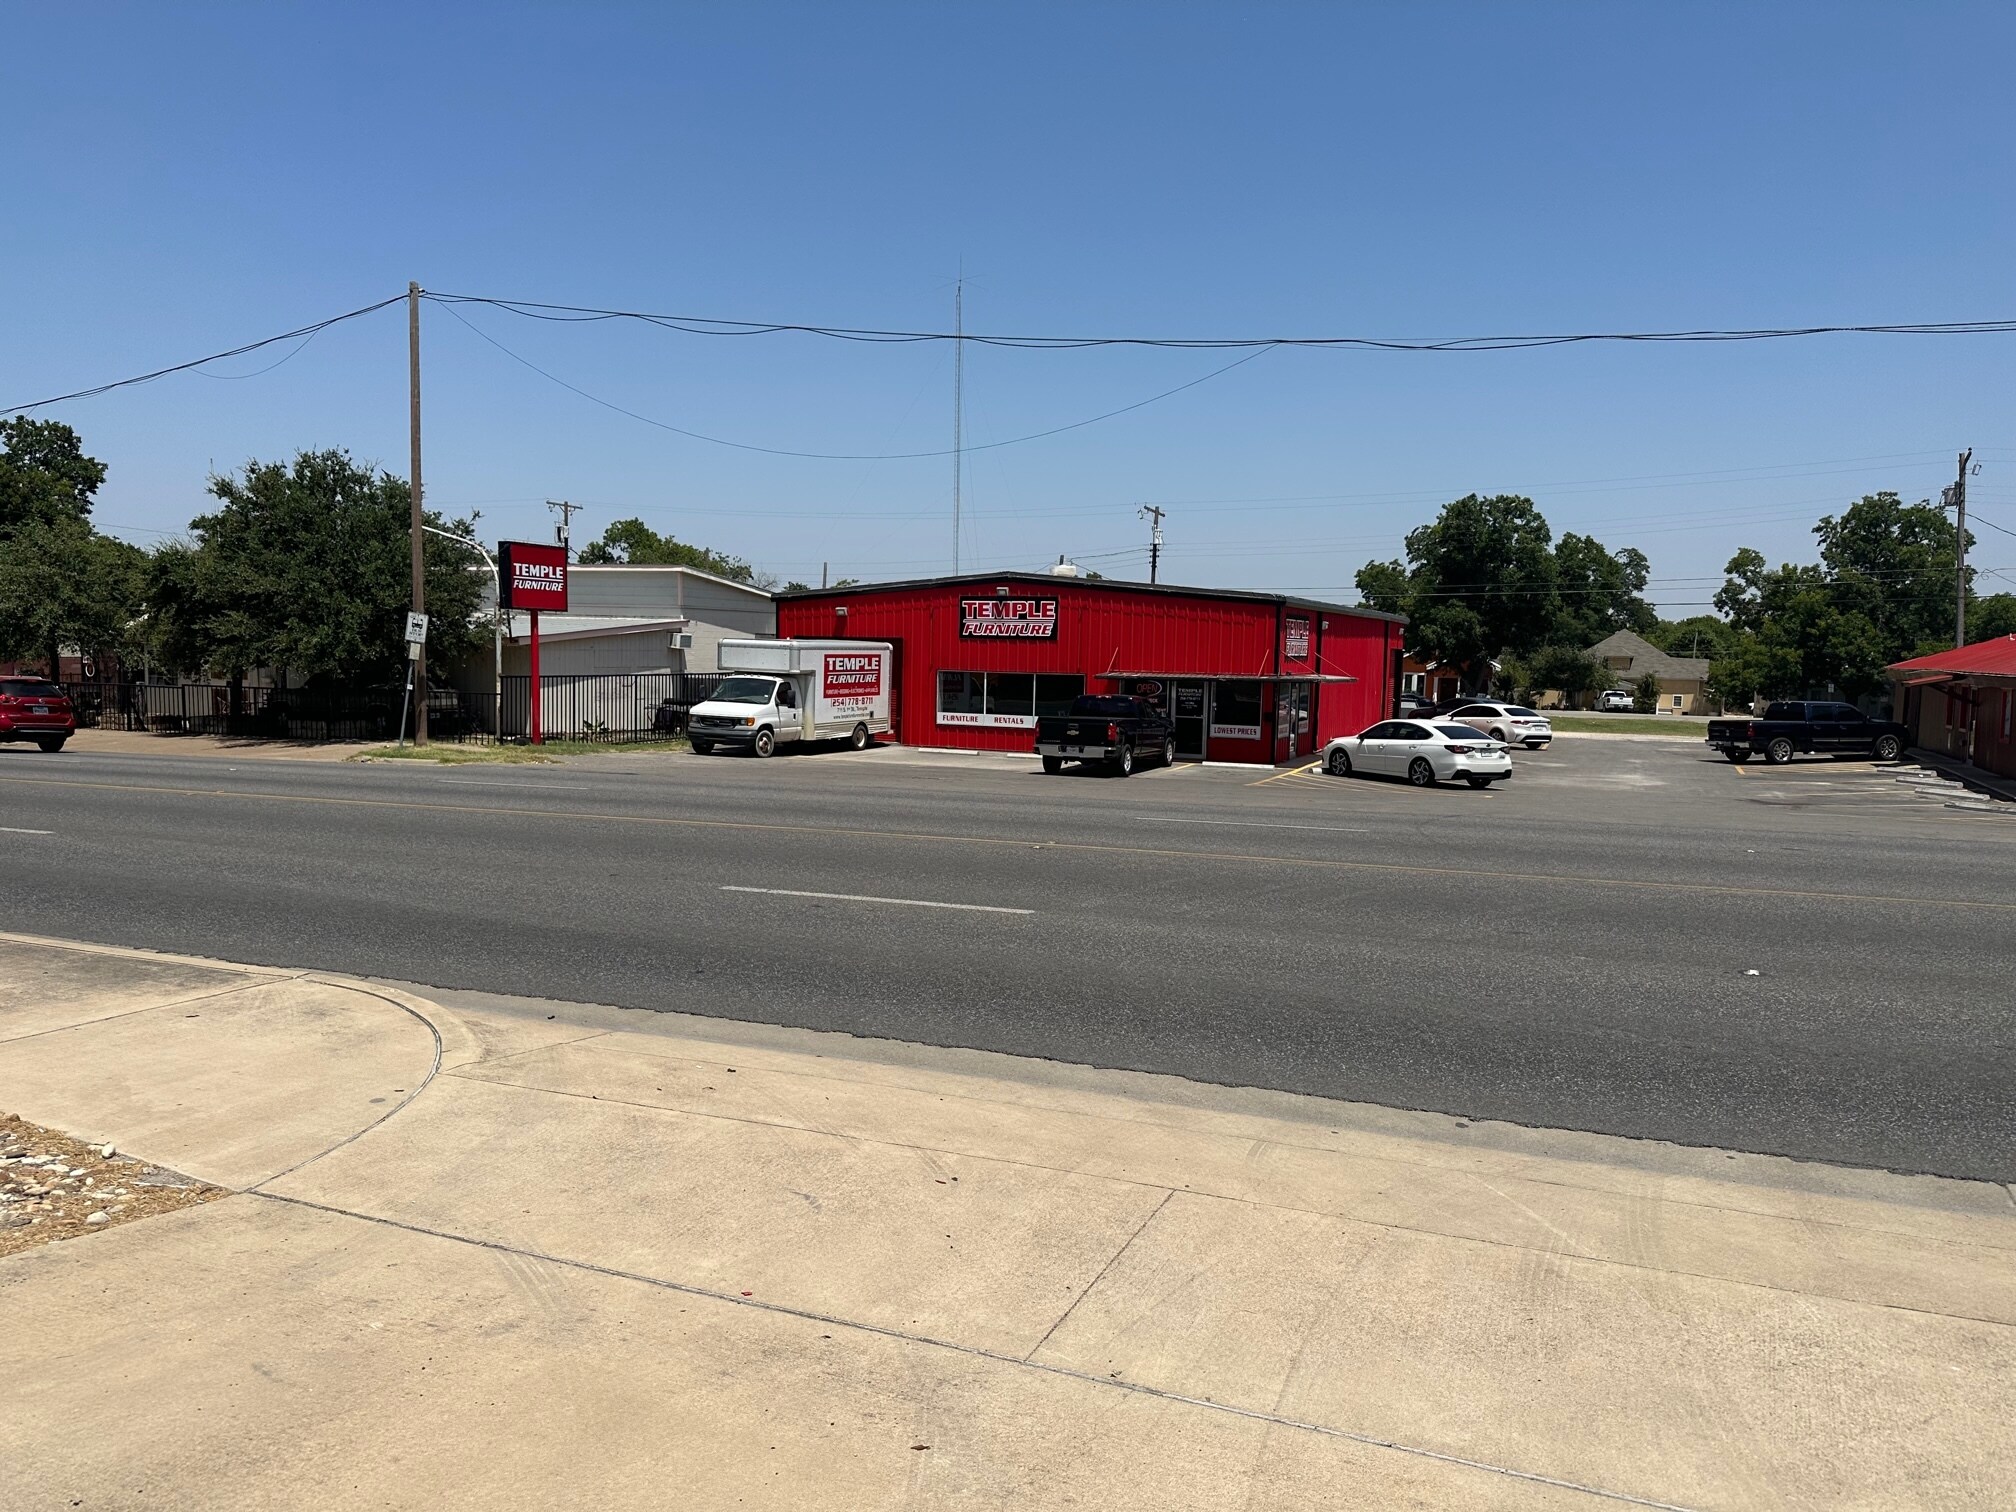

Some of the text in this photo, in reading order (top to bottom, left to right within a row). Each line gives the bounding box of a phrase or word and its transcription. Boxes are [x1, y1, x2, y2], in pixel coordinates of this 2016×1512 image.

[513, 563, 563, 578] TEMPLE
[513, 580, 564, 591] FURNITURE
[962, 600, 1056, 620] TEMPLE
[962, 623, 1053, 636] FURNITURE
[1286, 618, 1309, 639] TEMPLE
[826, 657, 879, 670] TEMPLE
[827, 674, 878, 684] FURNITURE
[1136, 683, 1158, 694] OPEN
[942, 714, 1024, 725] FURNITURE RENTALS
[1213, 726, 1257, 735] LOWEST PRICES
